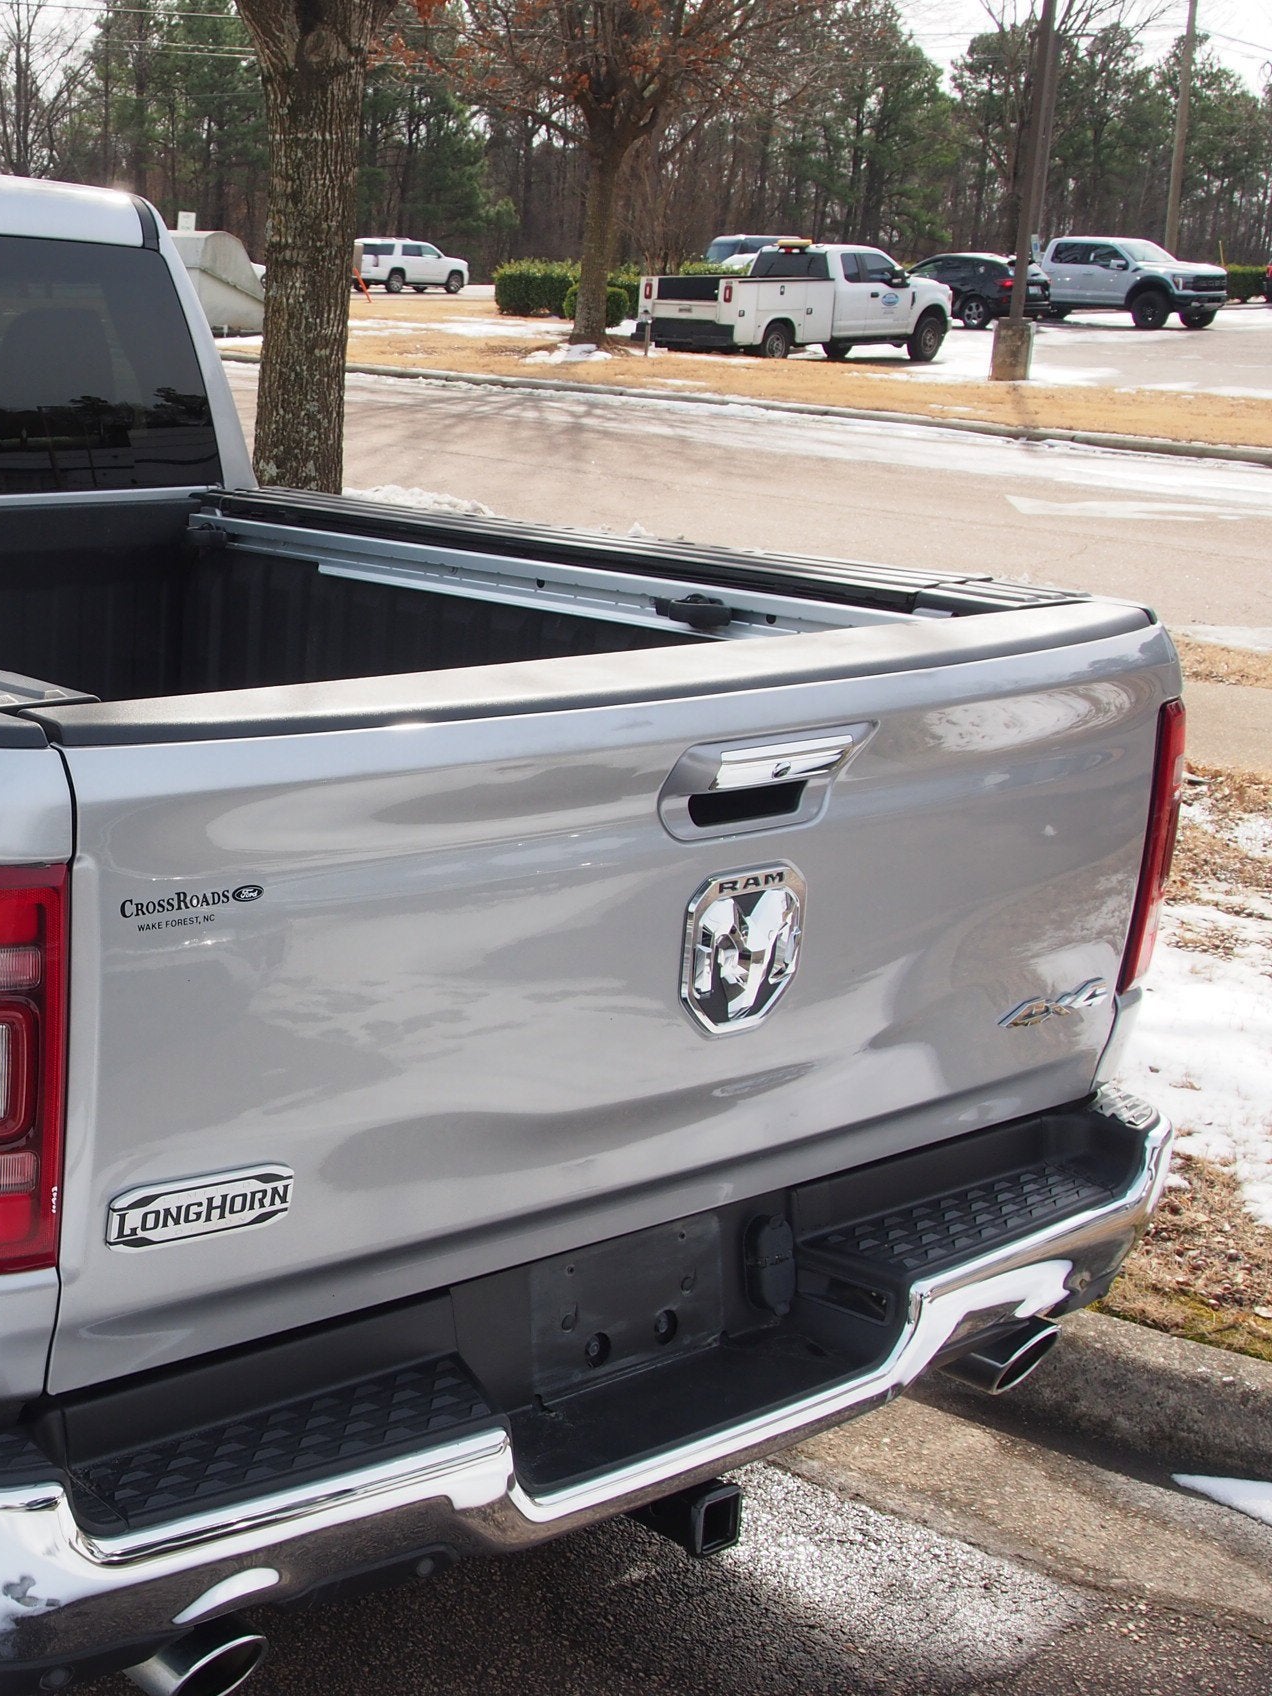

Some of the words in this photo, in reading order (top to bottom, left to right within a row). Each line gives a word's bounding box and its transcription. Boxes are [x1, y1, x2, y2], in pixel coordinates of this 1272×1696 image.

[719, 871, 785, 894] RAM
[137, 921, 163, 932] WAKE
[165, 916, 201, 928] FOREST,
[203, 914, 215, 923] NC
[114, 1183, 291, 1240] LONGHORN
